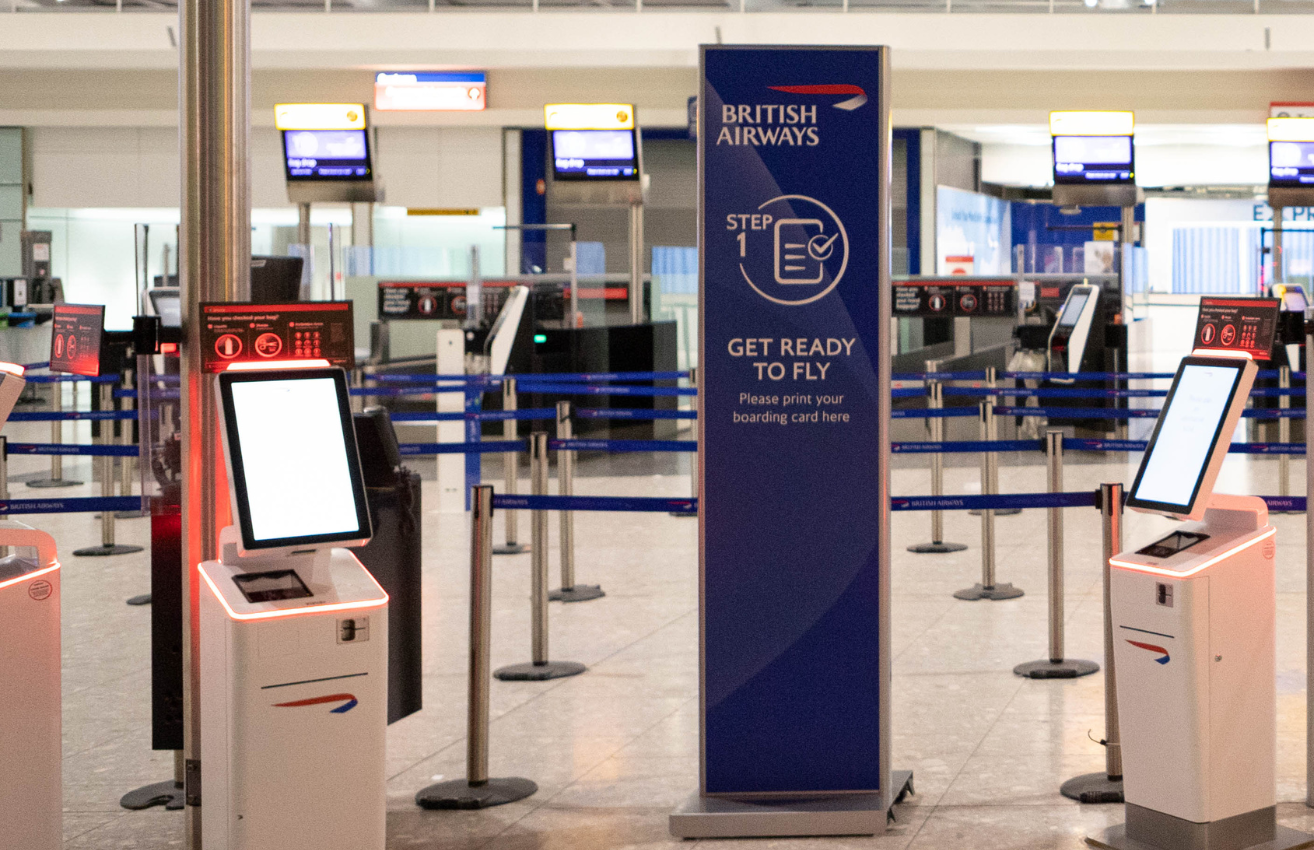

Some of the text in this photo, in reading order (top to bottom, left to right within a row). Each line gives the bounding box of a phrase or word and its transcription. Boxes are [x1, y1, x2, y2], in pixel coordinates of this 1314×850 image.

[722, 104, 817, 124] BRITISH
[716, 126, 820, 146] AIRWAYS
[727, 214, 773, 230] STEP
[736, 232, 746, 257] 1
[728, 338, 856, 356] GET READY
[753, 362, 831, 380] TO FLY
[739, 393, 844, 407] Please print your
[733, 411, 850, 424] boarding card here
